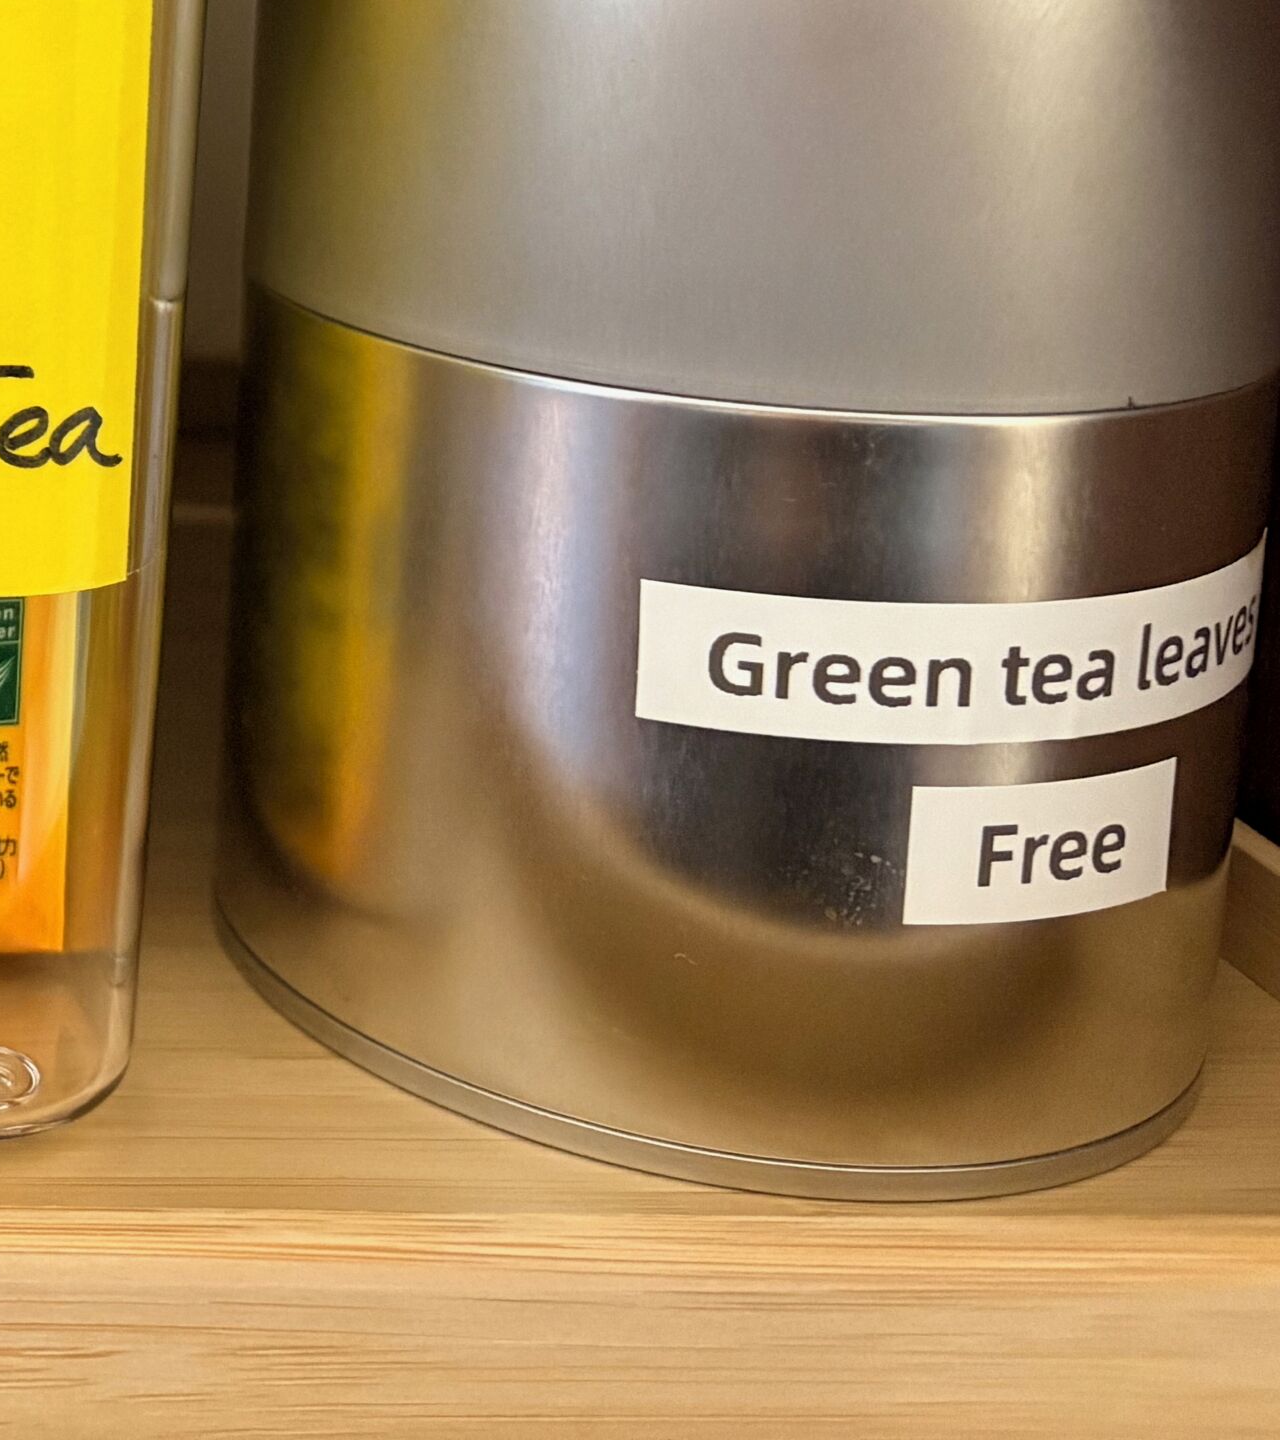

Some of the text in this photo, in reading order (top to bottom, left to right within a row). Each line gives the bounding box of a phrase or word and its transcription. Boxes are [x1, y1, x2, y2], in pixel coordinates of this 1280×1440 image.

[708, 594, 1257, 709] Green tea leaves
[977, 824, 1126, 888] Free
